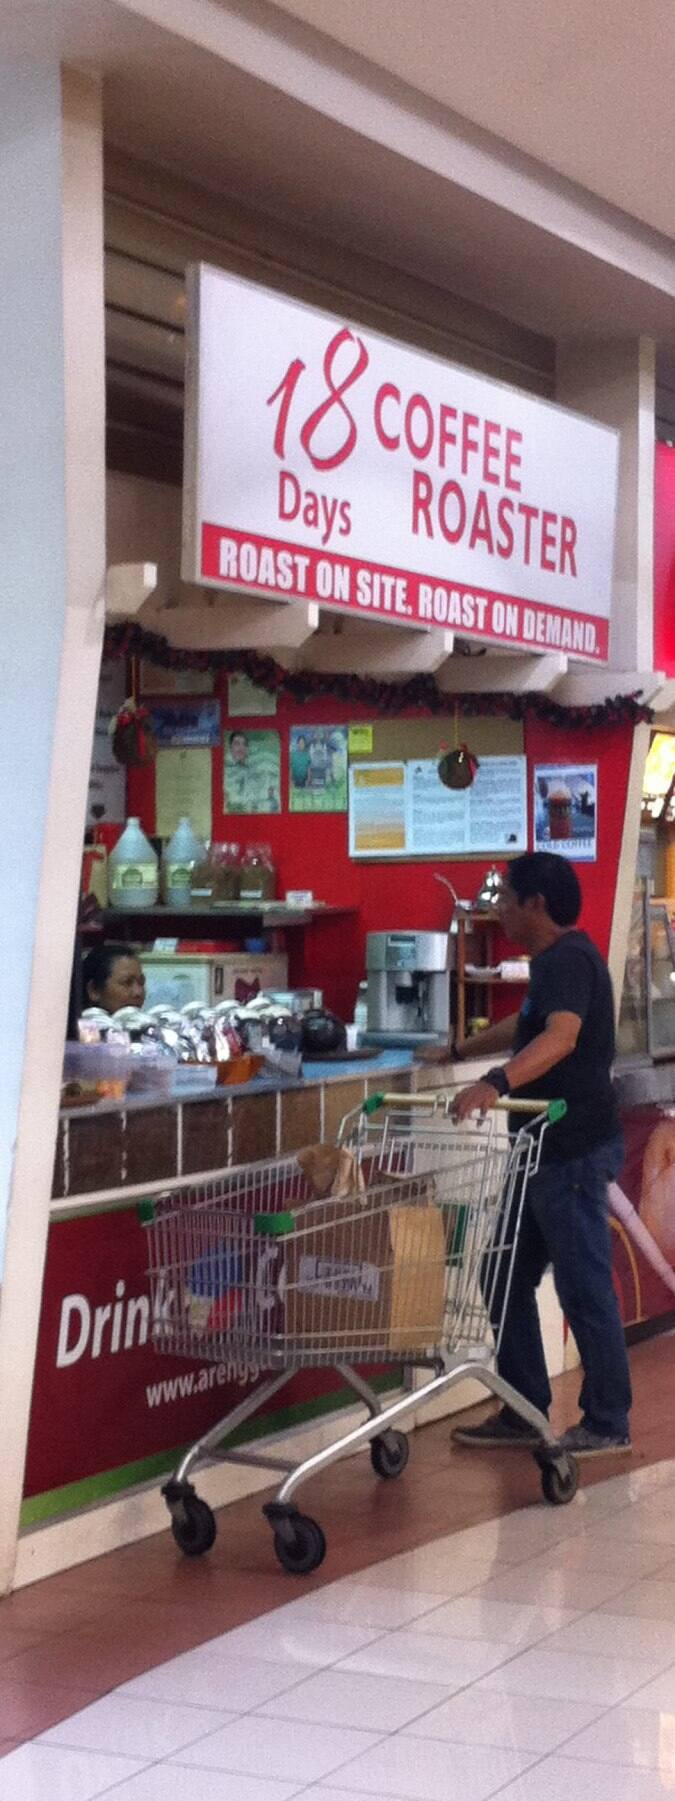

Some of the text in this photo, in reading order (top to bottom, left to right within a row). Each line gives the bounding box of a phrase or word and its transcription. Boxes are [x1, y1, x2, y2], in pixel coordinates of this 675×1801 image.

[266, 326, 523, 493] 18 COFFEE
[277, 470, 578, 578] Days ROASTER
[218, 537, 601, 654] ROAST ON SITE. ROAST ON DEMAND.
